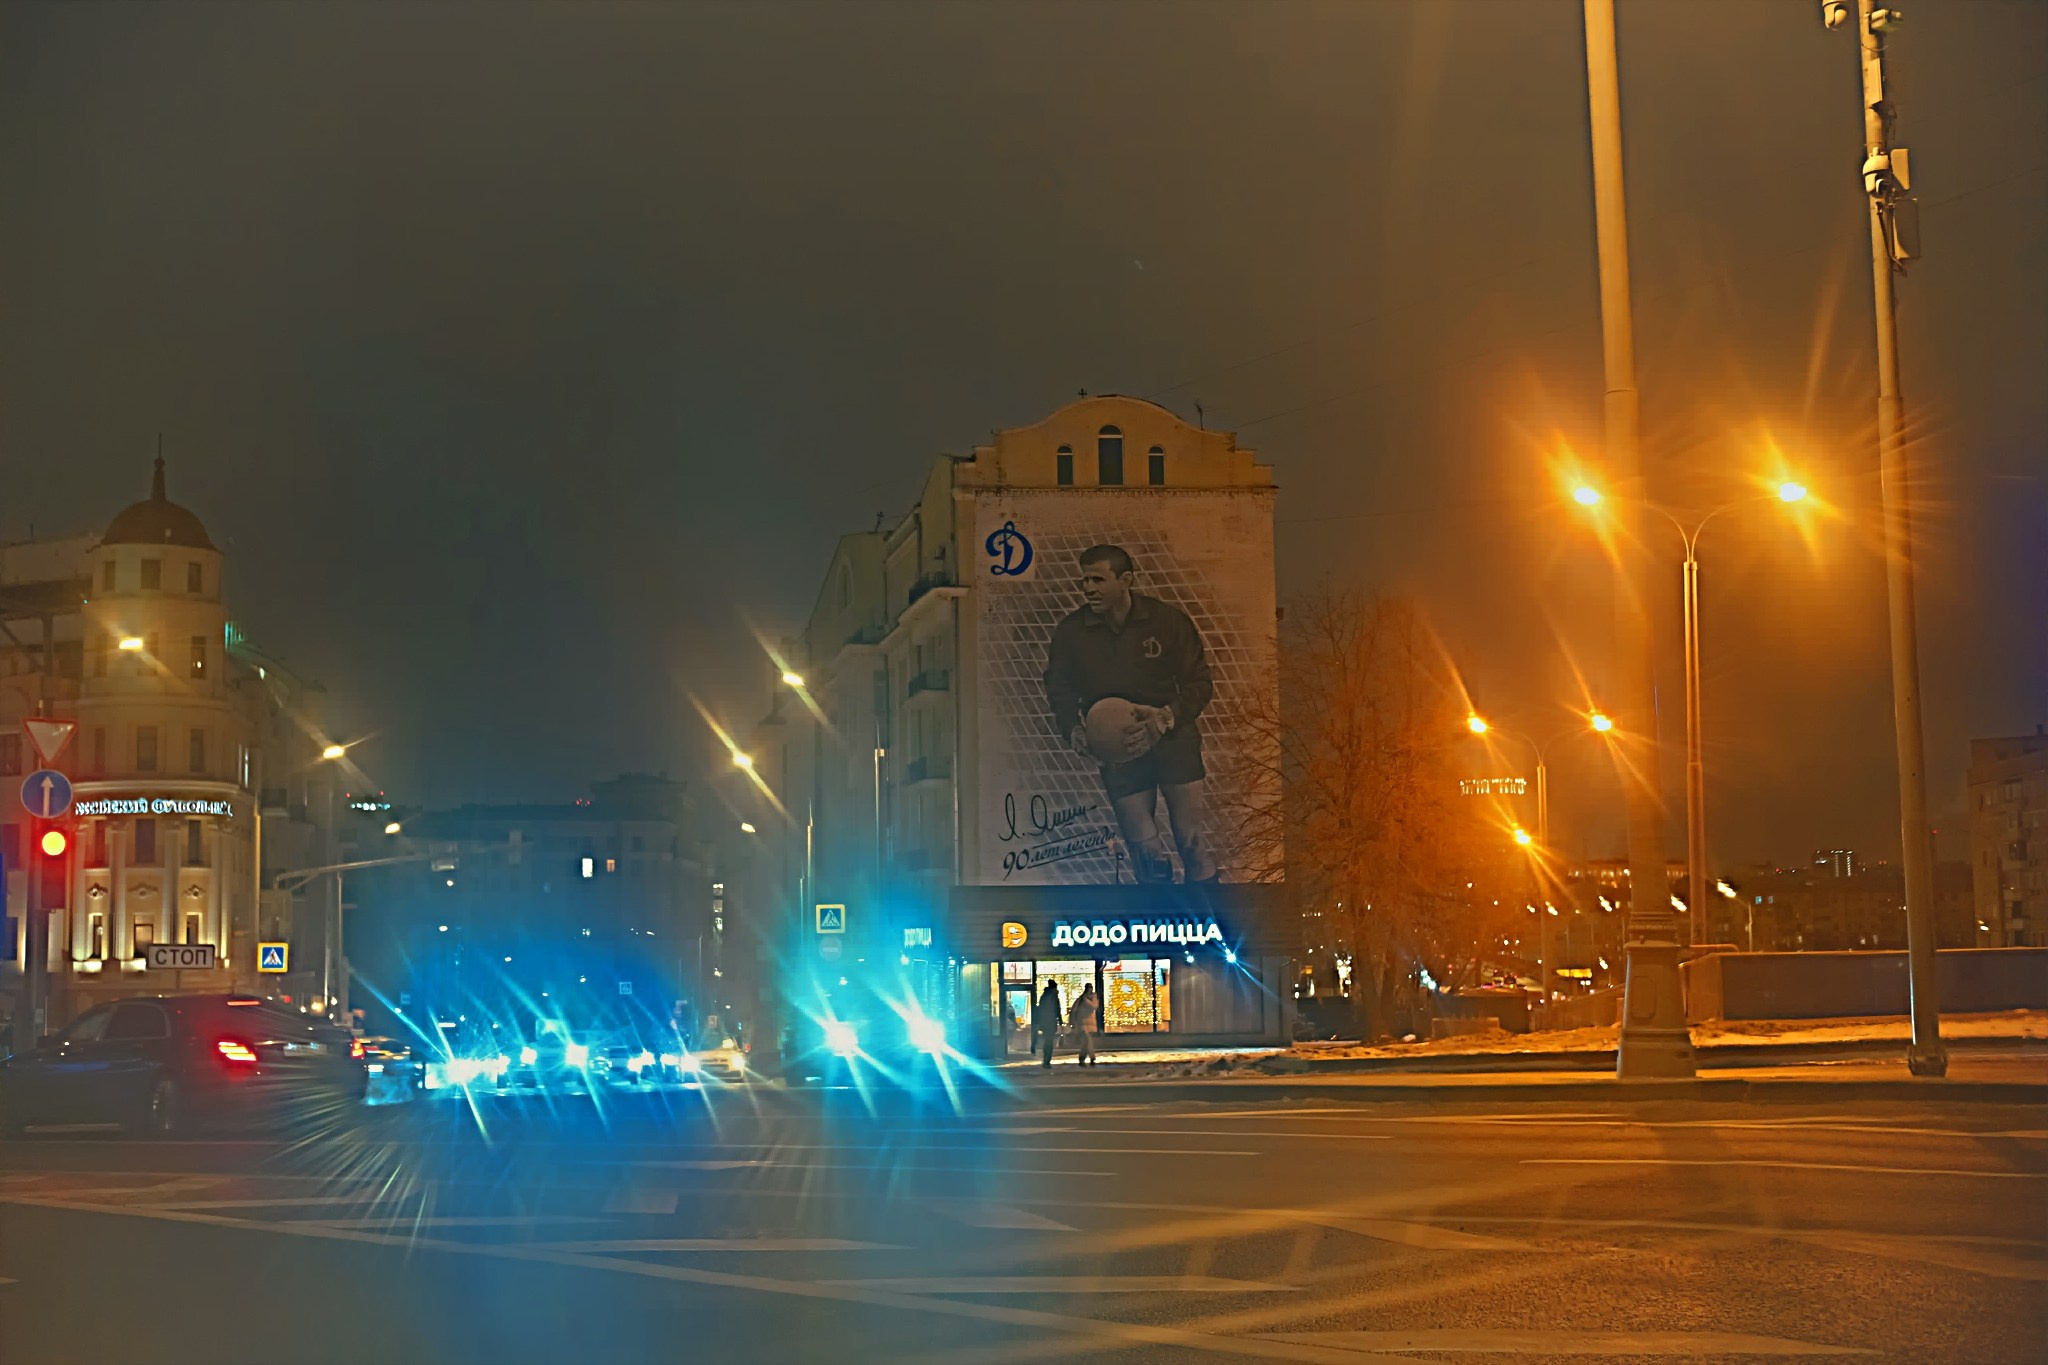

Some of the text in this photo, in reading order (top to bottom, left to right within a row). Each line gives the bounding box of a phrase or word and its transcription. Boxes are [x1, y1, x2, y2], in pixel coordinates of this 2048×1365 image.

[1003, 848, 1030, 881] 90
[1031, 845, 1060, 863] лет
[1052, 923, 1223, 947] ДОДО ПИЦЦА
[155, 949, 207, 965] СТОП
